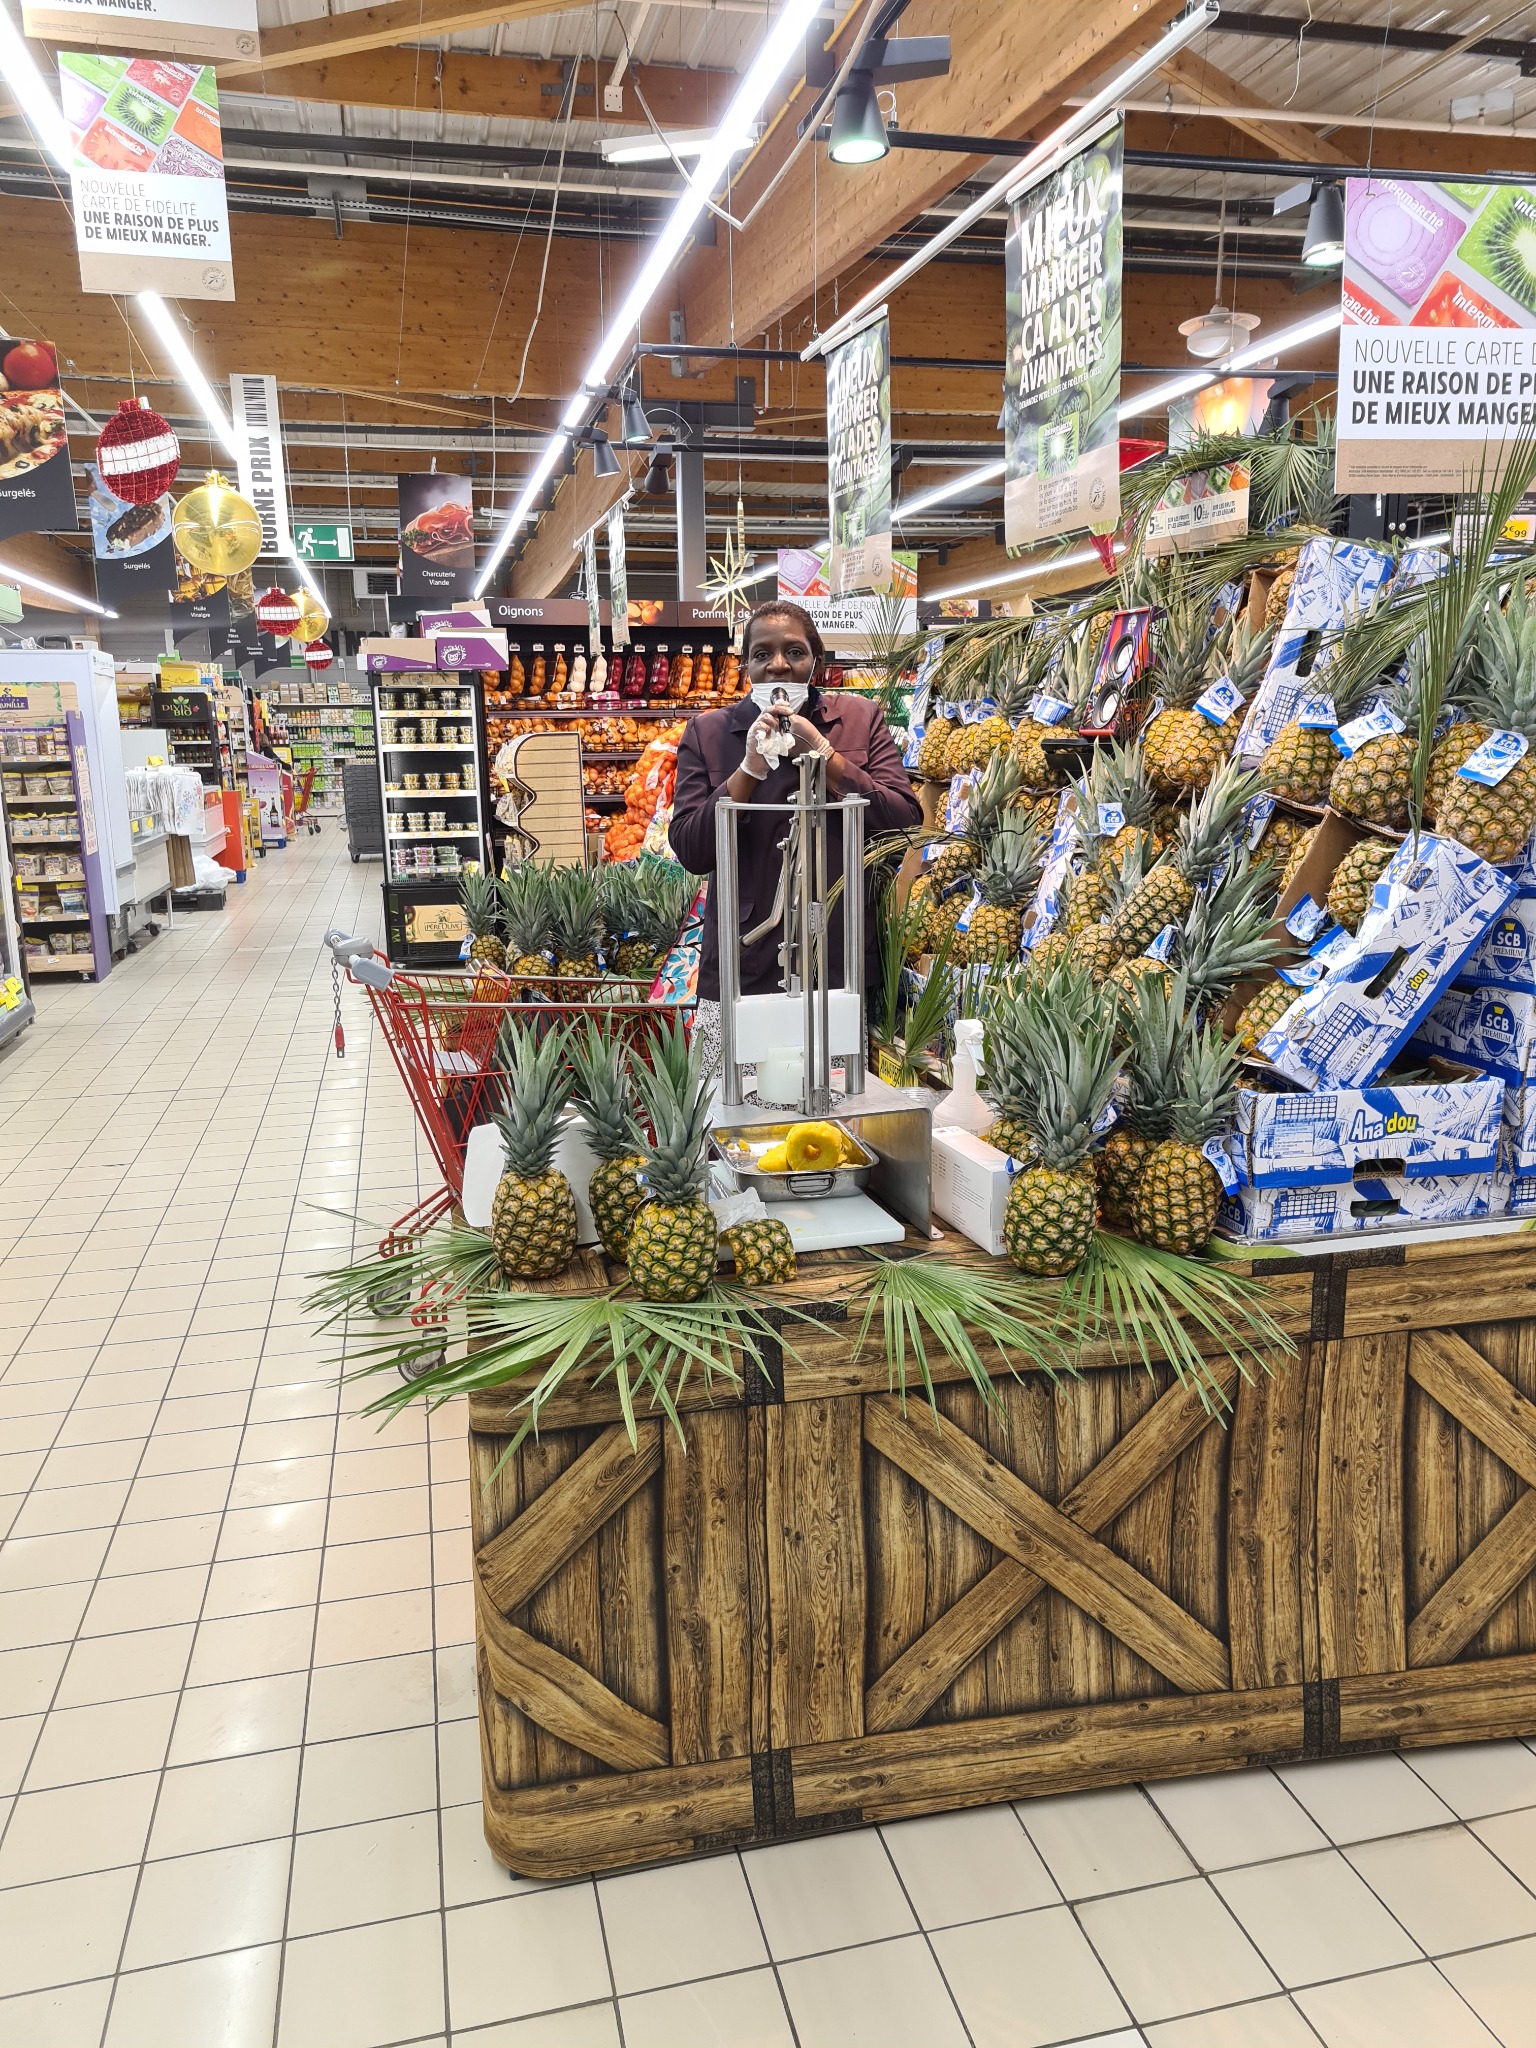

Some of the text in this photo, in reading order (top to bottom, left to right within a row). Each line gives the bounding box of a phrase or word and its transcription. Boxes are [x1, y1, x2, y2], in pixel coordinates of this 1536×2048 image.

[80, 179, 146, 197] NOUVELLE
[81, 194, 197, 217] CARTE DE FIDÉLITÉ
[83, 210, 219, 233] UNE RAISON DE PLUS
[1020, 167, 1105, 276] MIEUX
[84, 225, 211, 247] DE MIEUX MANGER.
[1020, 232, 1103, 319] MANGER
[1021, 277, 1106, 365] ÇA A DES
[1355, 338, 1458, 365] NOUVELLE
[1464, 340, 1524, 366] CARTE
[1019, 327, 1104, 397] AVANTAGES
[1353, 370, 1396, 394] UNE
[1402, 370, 1479, 395] RAISON
[1486, 371, 1513, 395] DE
[1352, 400, 1379, 425] DE
[1385, 401, 1451, 425] MIEUX
[248, 436, 273, 483] PRIX
[252, 488, 279, 554] BORNE
[1193, 504, 1203, 523] 10
[1149, 516, 1155, 535] 5
[123, 562, 151, 571] Surgelés
[422, 570, 456, 578] Charcuterie
[498, 605, 544, 619] Oignons
[823, 600, 846, 609] CARTE
[847, 601, 858, 609] DE
[822, 621, 858, 629] MANGER.
[832, 611, 843, 619] DE
[844, 611, 863, 620] PLUS
[1216, 687, 1232, 706] SCB
[161, 704, 193, 712] DIVIN
[1498, 739, 1518, 751] SCB
[1106, 816, 1120, 824] SCB
[1496, 931, 1521, 947] SCB
[1492, 946, 1523, 958] PREMIUM
[1392, 967, 1430, 1017] Ana'dou
[1485, 1013, 1510, 1032] SCB
[1481, 1027, 1511, 1043] PREMIUM
[1350, 1110, 1417, 1142] Ana'dou
[1220, 1201, 1241, 1222] SCB
[1216, 1213, 1245, 1235] PREMIUM
